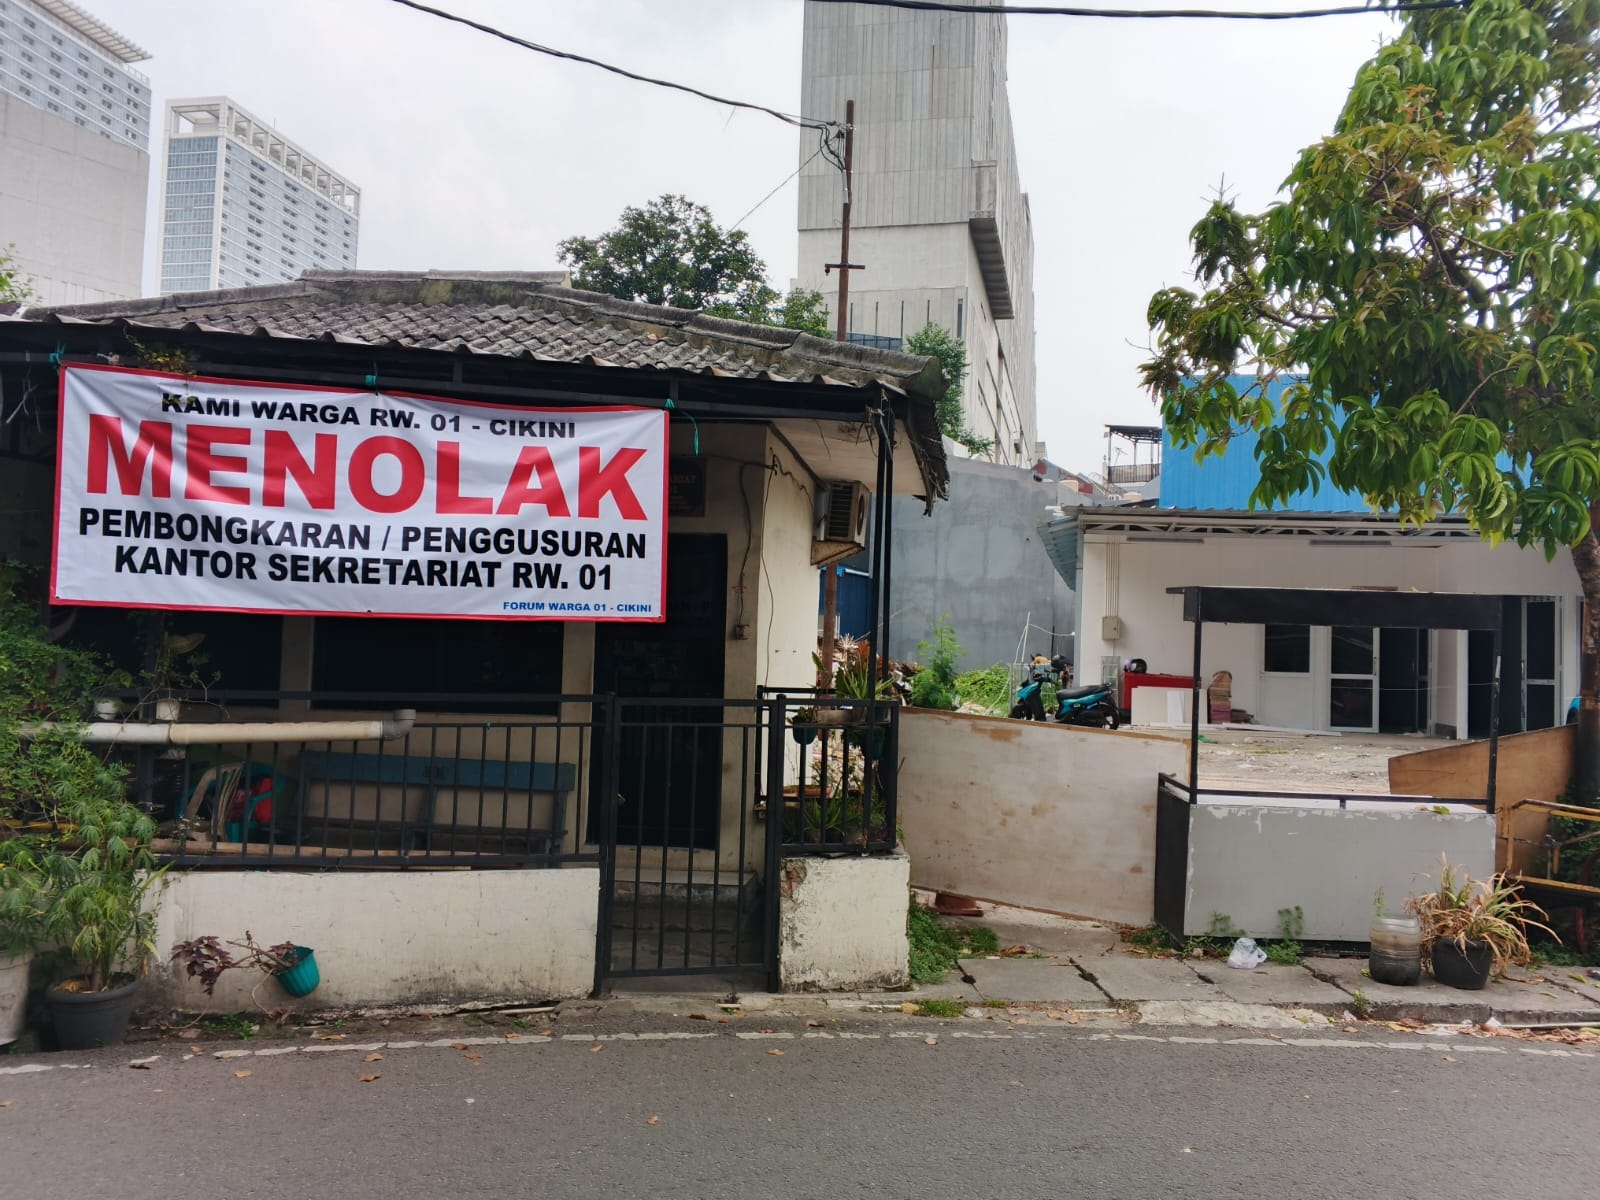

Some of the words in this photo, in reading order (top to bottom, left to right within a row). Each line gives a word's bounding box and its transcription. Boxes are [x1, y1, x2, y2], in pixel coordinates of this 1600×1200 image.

[162, 393, 240, 417] KAMI
[252, 401, 360, 425] WARGA
[370, 408, 420, 429] RW.
[430, 414, 461, 432] 01
[490, 419, 576, 438] CIKINI
[87, 413, 648, 520] MENOLAK
[79, 507, 371, 550] PEMBONGKARAN
[381, 525, 392, 551] /
[402, 527, 647, 558] PENGGUSURAN
[115, 545, 257, 580] KANTOR
[268, 553, 501, 588] SEKRETARIAT
[512, 562, 569, 589] RW.
[579, 564, 611, 590] 01
[503, 601, 545, 610] FORUM
[548, 602, 591, 611] WARGA
[594, 604, 606, 612] 01
[616, 604, 652, 612] CIKINI
